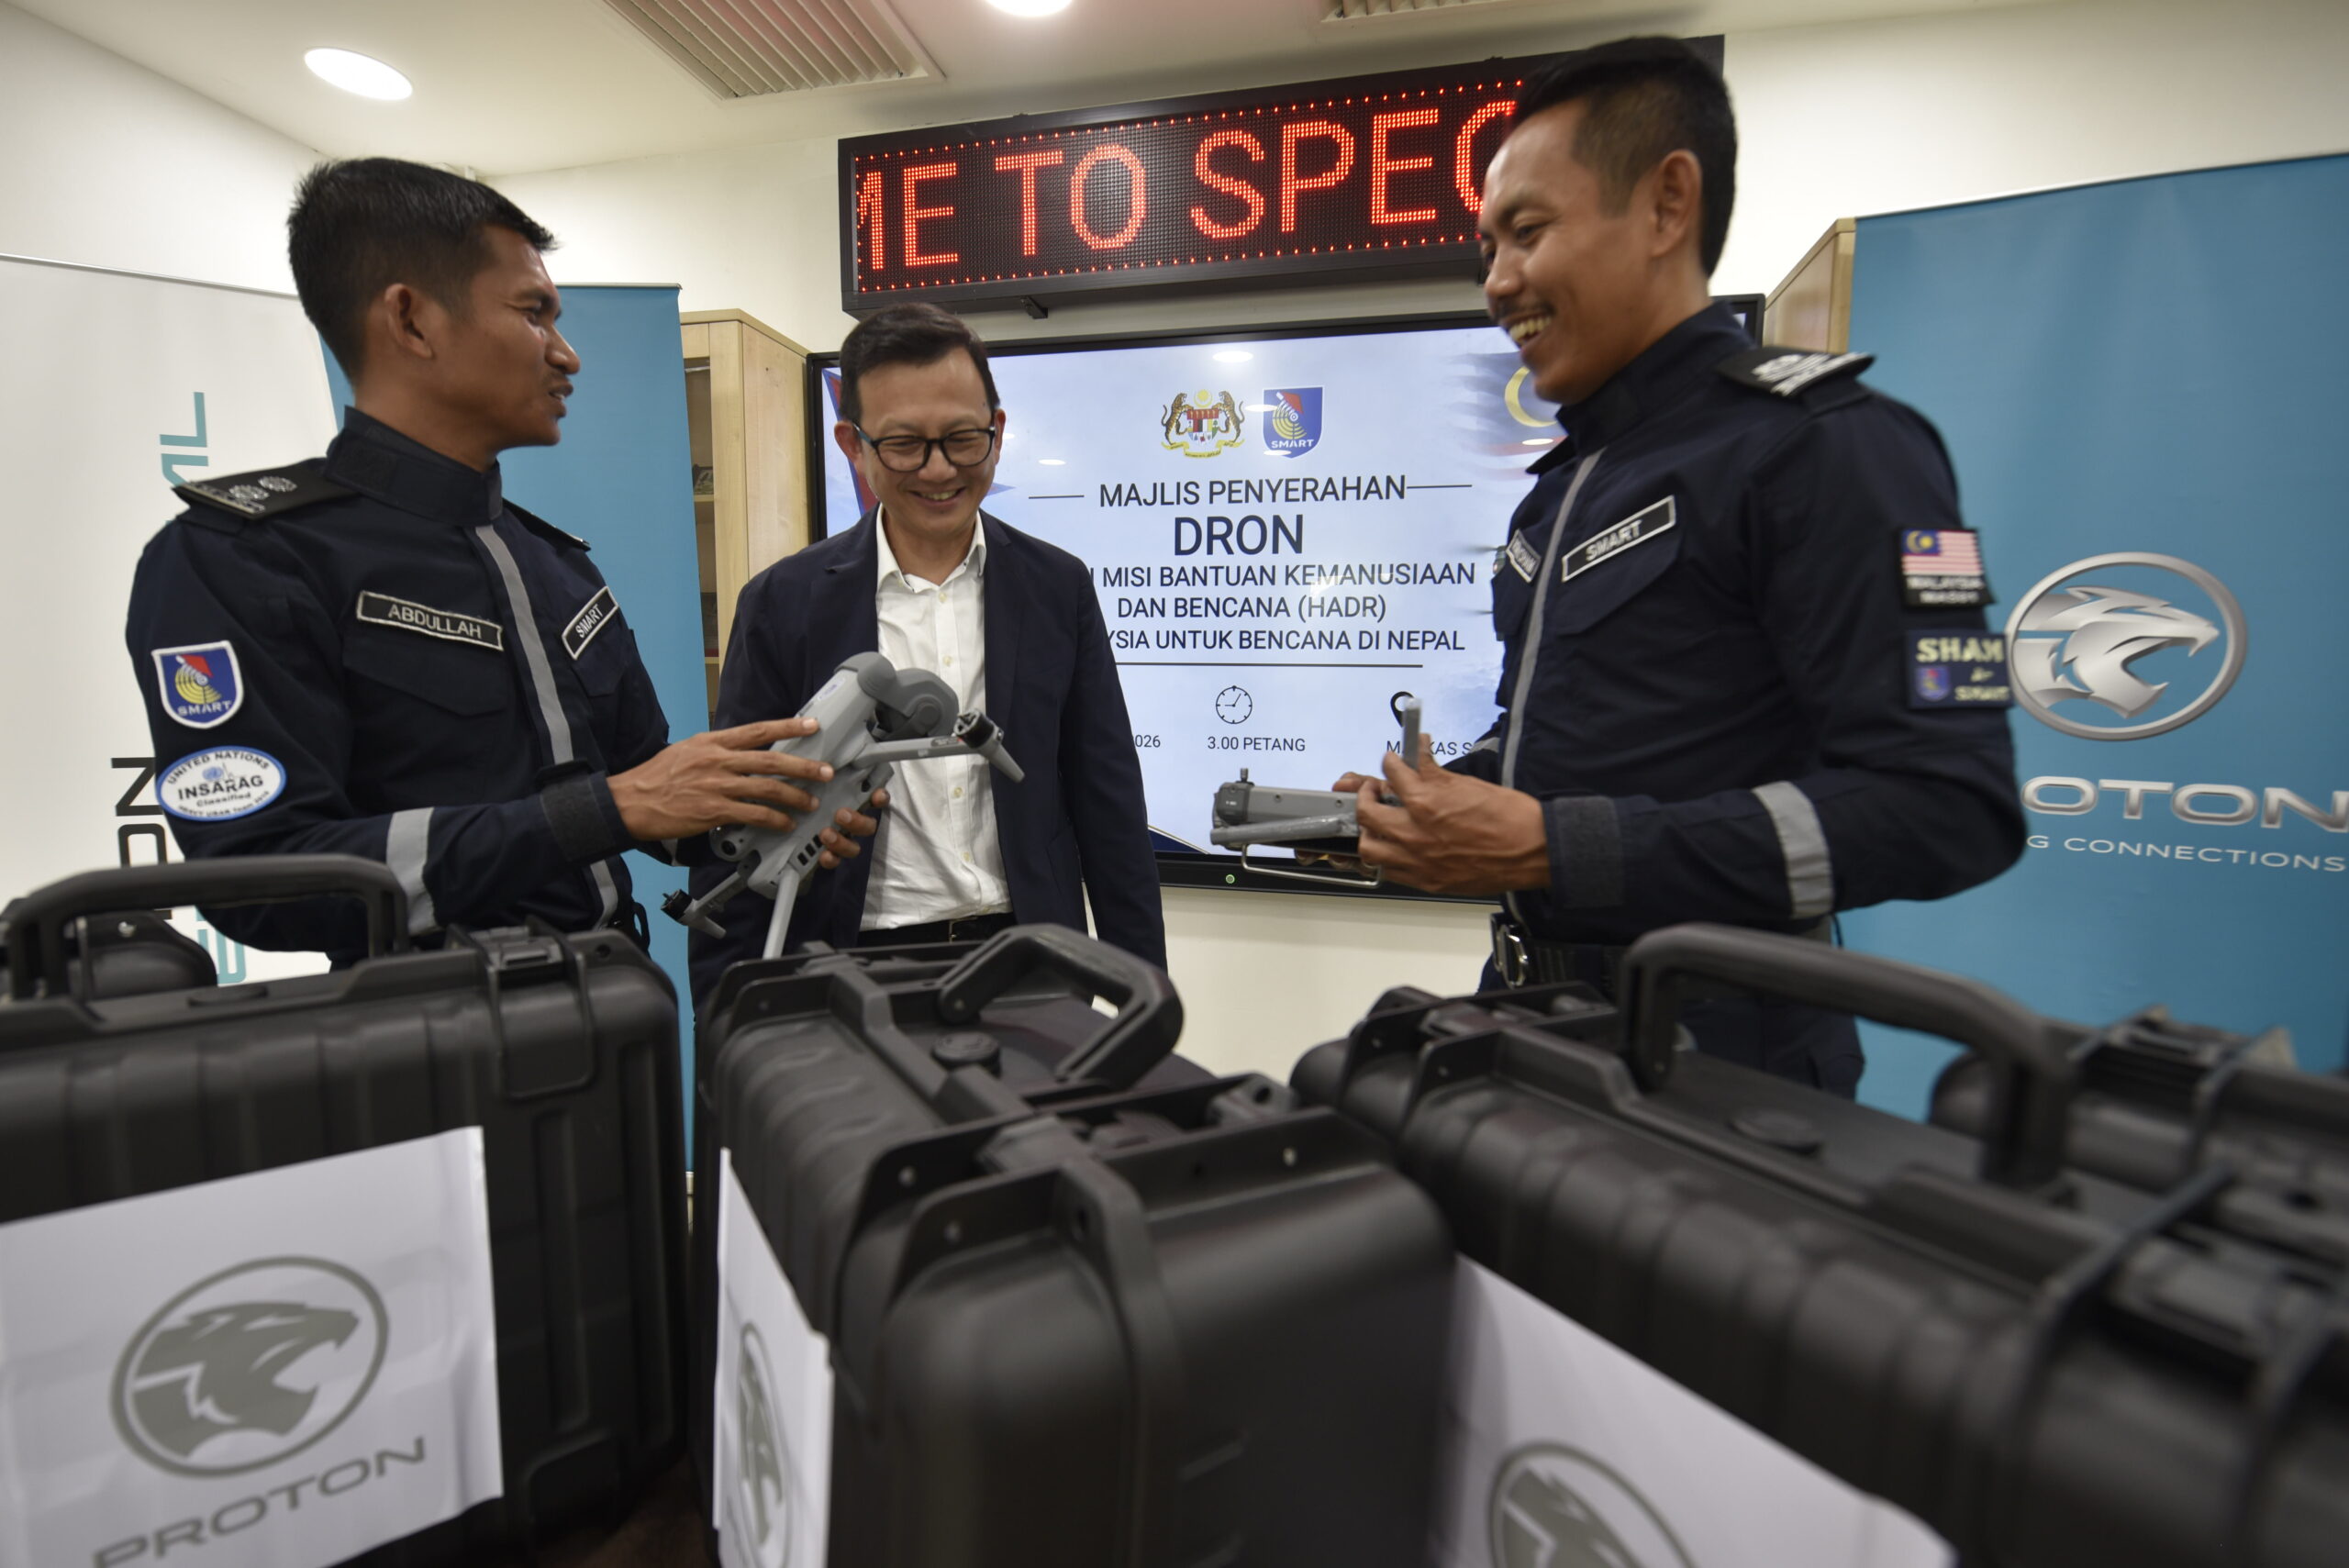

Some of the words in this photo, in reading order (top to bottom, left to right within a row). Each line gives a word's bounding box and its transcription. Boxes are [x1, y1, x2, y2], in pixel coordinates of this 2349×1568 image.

[995, 144, 1146, 256] TO
[1272, 439, 1315, 449] SMART
[1100, 480, 1200, 507] MAJLIS
[1209, 474, 1406, 505] PENYERAHAN
[1174, 514, 1304, 556] DRON
[1585, 519, 1642, 562] SMART
[1103, 566, 1151, 587] MISI
[1160, 564, 1276, 587] BANTUAN
[1285, 562, 1475, 586] KEMANUSIAAN
[388, 603, 482, 639] ABDULLAH
[575, 604, 605, 639] SMART
[1118, 597, 1166, 618] DAN
[1174, 596, 1291, 618] BENCANA
[1298, 594, 1386, 623] (HADR)
[1156, 629, 1233, 650] UNTUK
[1239, 629, 1352, 650] BENCANA
[1358, 630, 1380, 651] DI
[1387, 630, 1465, 651] NEPAL
[177, 700, 232, 717] SMART
[1207, 736, 1240, 751] 3.00
[1242, 737, 1307, 752] PETANG
[167, 755, 210, 785] UNITED
[215, 751, 271, 771] NATIONS
[177, 774, 264, 801] INSARAG
[2064, 838, 2346, 873] CONNECTIONS
[93, 1435, 427, 1568] PROTON
